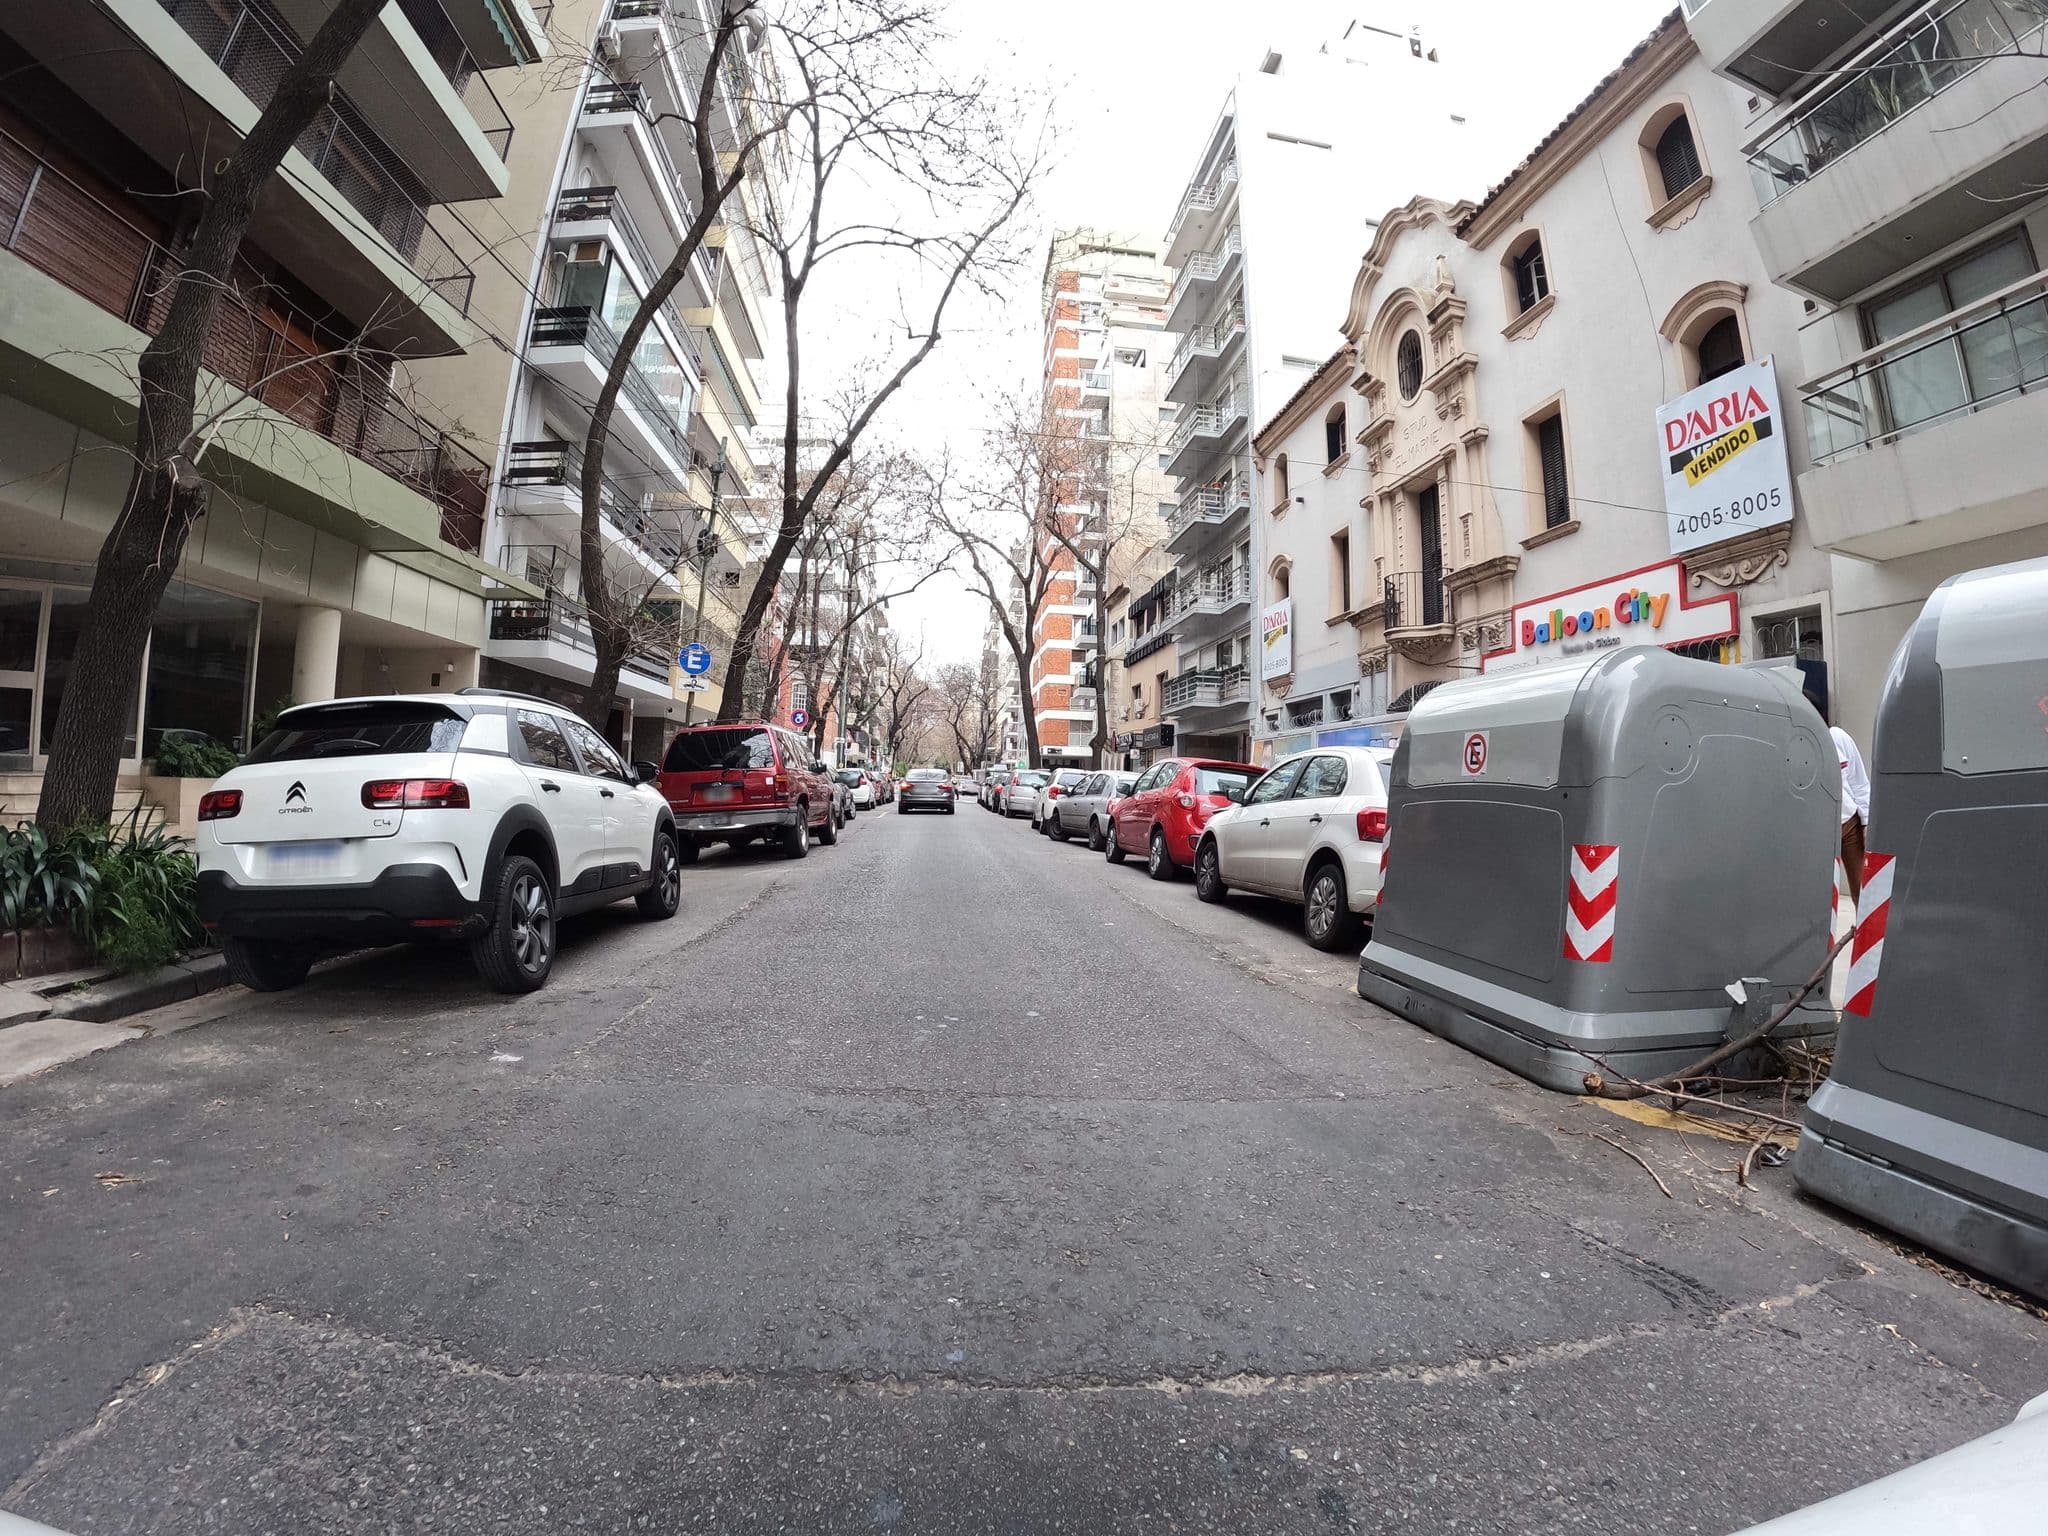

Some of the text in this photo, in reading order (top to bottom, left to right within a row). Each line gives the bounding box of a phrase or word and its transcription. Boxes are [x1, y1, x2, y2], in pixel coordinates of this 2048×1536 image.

[1665, 384, 1770, 452] D'ARIA
[1689, 428, 1751, 479] VENDIDO
[1521, 588, 1670, 647] Balloon City
[687, 650, 702, 669] E
[373, 819, 391, 827] C4
